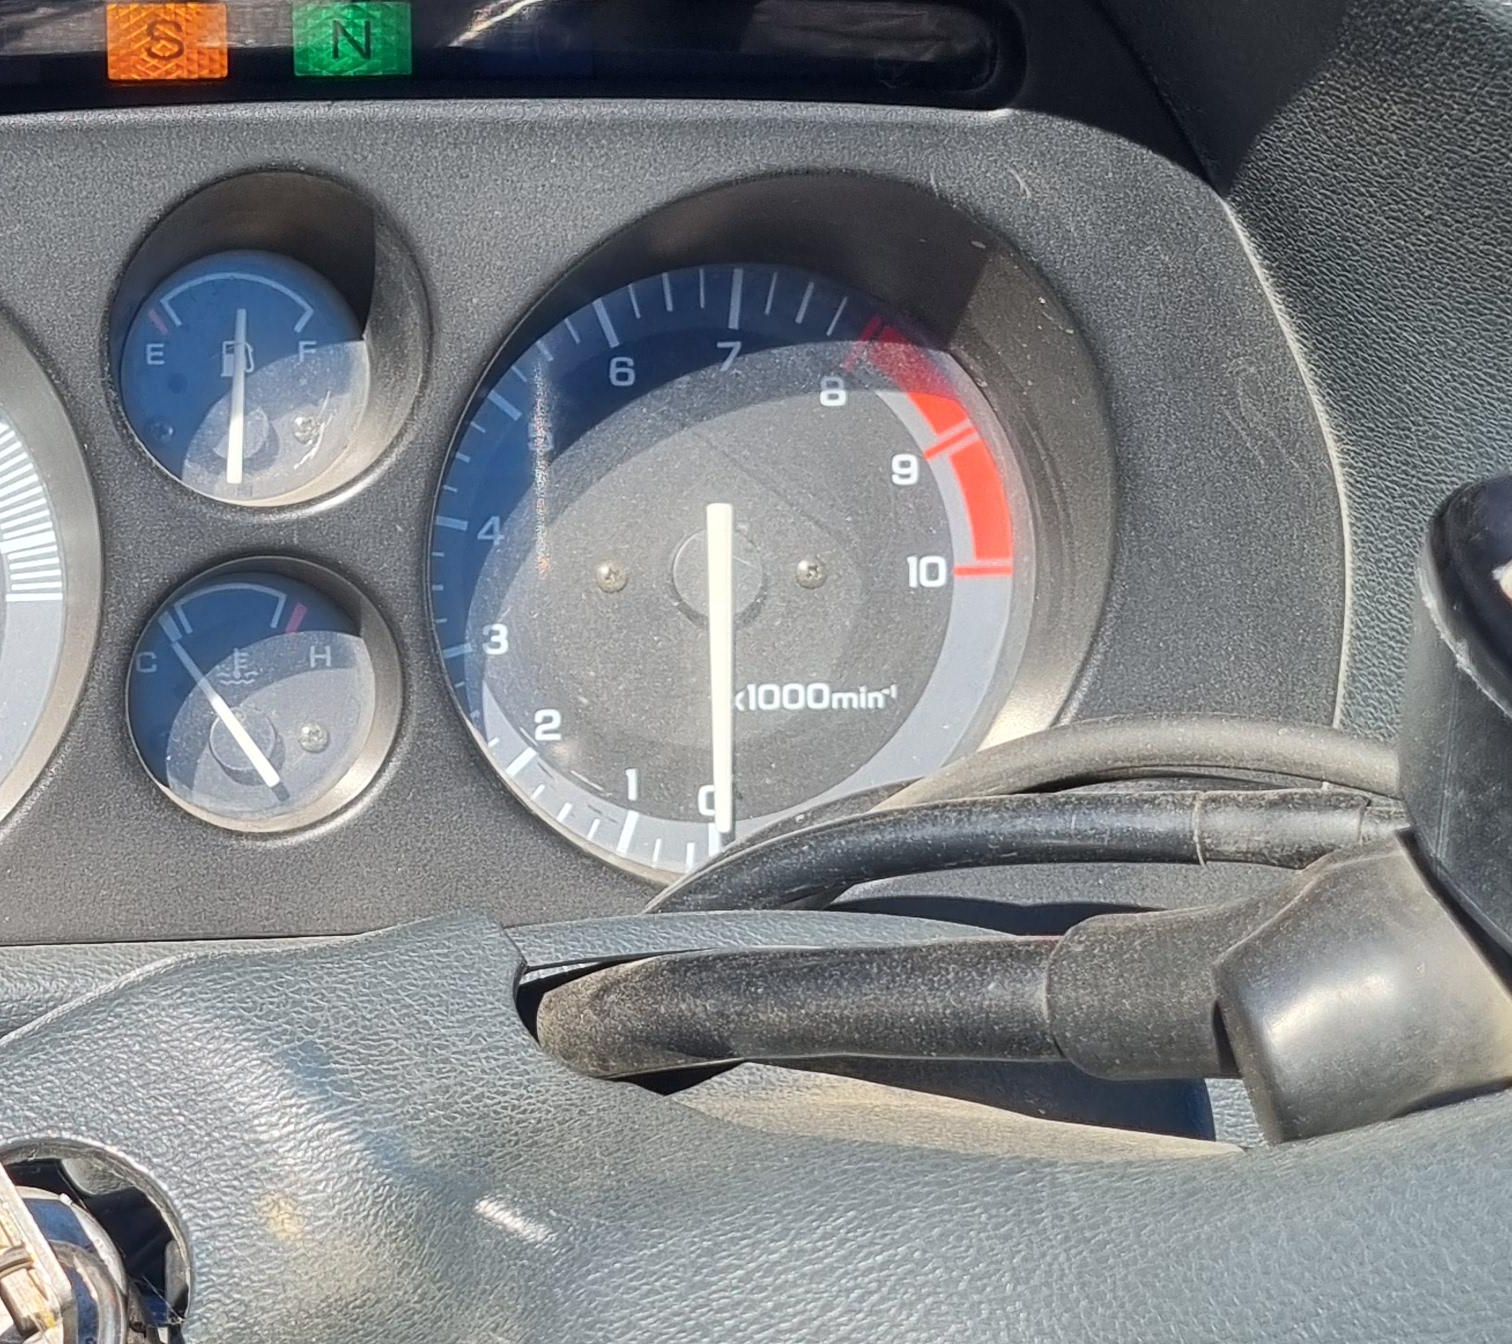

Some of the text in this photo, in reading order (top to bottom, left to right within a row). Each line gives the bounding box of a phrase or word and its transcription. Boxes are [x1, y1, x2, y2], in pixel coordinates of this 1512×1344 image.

[145, 18, 185, 59] S
[332, 18, 372, 60] N
[145, 342, 165, 365] E
[298, 340, 317, 363] F
[715, 341, 742, 371] 7
[608, 356, 636, 387] 6
[819, 376, 846, 407] 8
[891, 454, 919, 485] 9
[476, 517, 503, 544] 4
[907, 555, 947, 588] 10
[482, 623, 509, 655] 3
[309, 645, 332, 668] H
[533, 709, 562, 741] 2
[625, 768, 638, 800] 1
